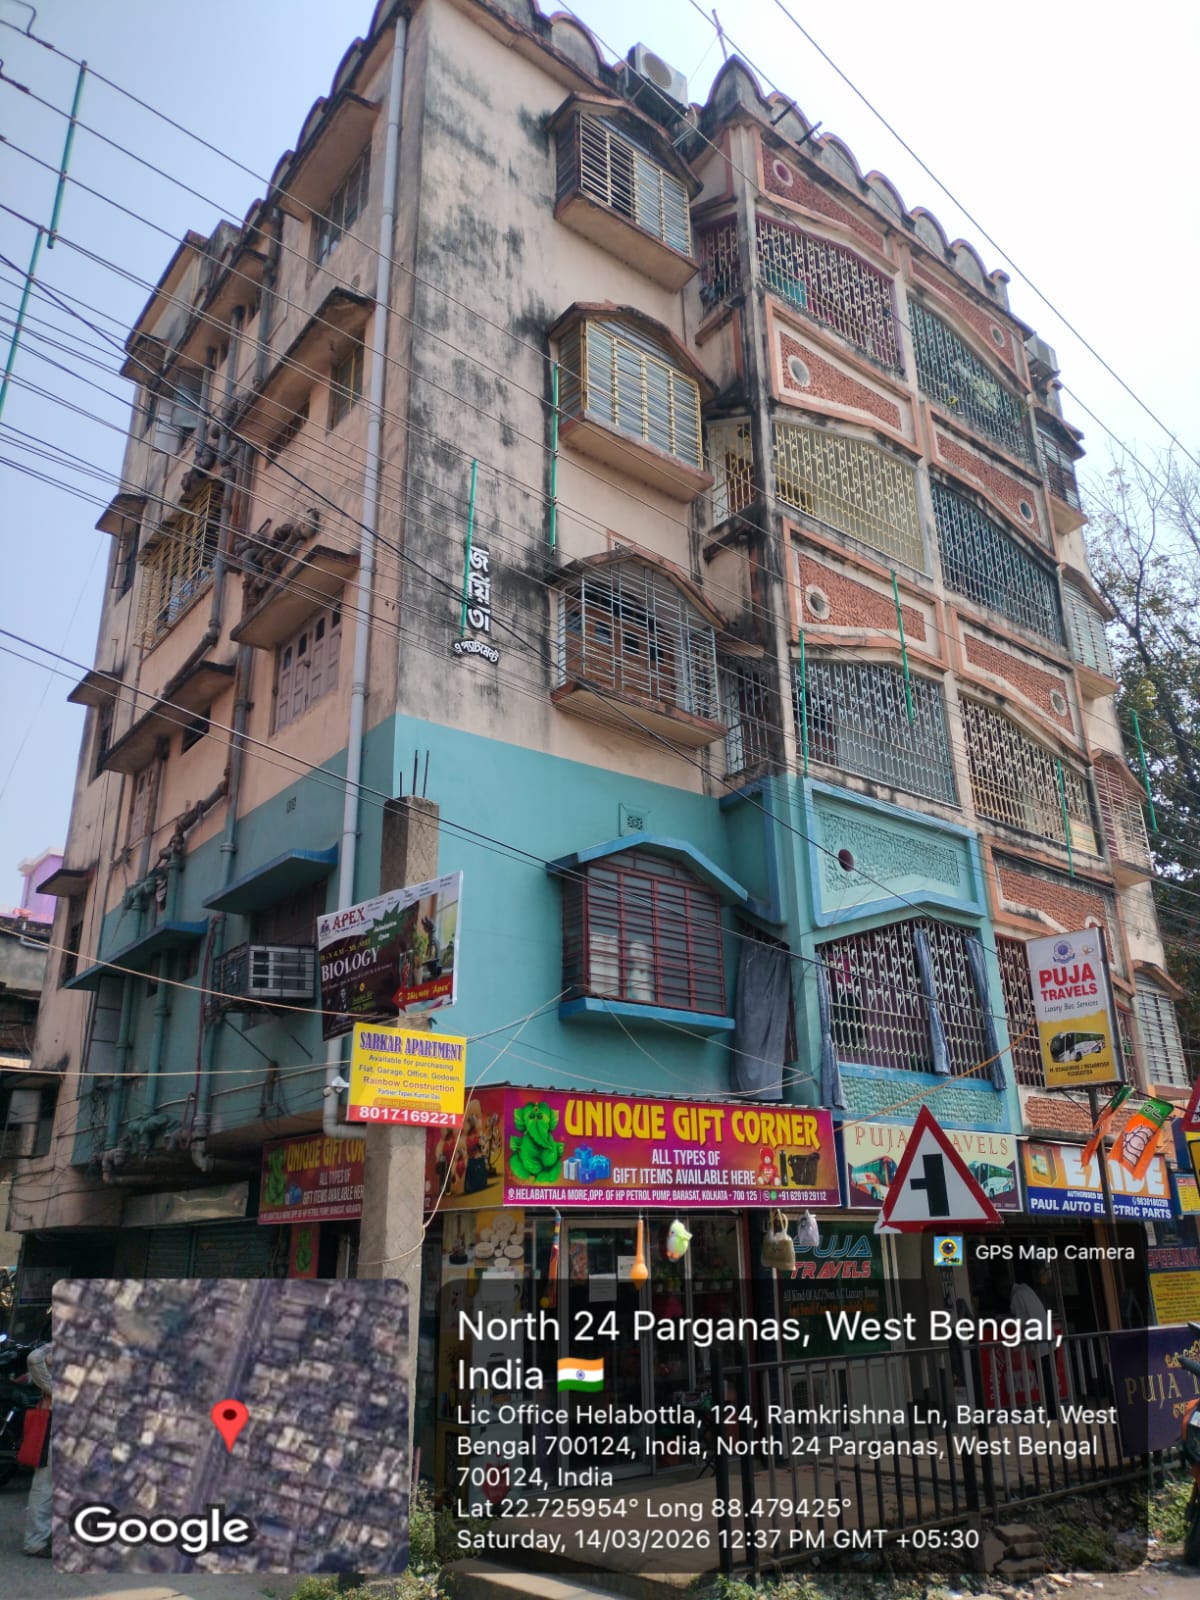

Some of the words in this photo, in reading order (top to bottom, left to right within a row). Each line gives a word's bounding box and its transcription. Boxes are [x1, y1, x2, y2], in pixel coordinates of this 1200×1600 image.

[332, 907, 366, 930] APEX
[321, 945, 380, 982] BIOLOGY
[1038, 963, 1096, 988] PUJA
[1040, 983, 1098, 1002] TRAVELS
[1044, 1004, 1063, 1014] Luxury
[1064, 1002, 1075, 1010] Bus
[360, 1031, 403, 1054] SARKAR
[404, 1037, 464, 1062] APARTMENT
[368, 1055, 401, 1065] Available
[415, 1059, 454, 1071] purchasing
[363, 1076, 400, 1087] Rainbow
[403, 1080, 454, 1093] Construction
[359, 1106, 457, 1125] 8017169221
[564, 1099, 666, 1140] UNIQUE
[673, 1107, 725, 1145] GIFT
[731, 1110, 821, 1149] CORNER
[855, 1126, 909, 1153] PUJA
[952, 1136, 1009, 1156] AVELS
[287, 1140, 321, 1172] UNIQUE
[322, 1137, 342, 1168] GIFT
[651, 1149, 671, 1165] ALL
[673, 1150, 705, 1166] TYPES
[708, 1150, 720, 1166] OF
[613, 1168, 637, 1184] GIFT
[640, 1168, 673, 1185] ITEMS
[675, 1169, 729, 1185] AVAILABLE
[731, 1170, 756, 1185] HERE
[353, 1185, 364, 1200] HER
[515, 1188, 566, 1200] HELABATTALA
[605, 1189, 614, 1200] OF
[616, 1189, 625, 1200] HP
[626, 1189, 651, 1201] PETROL
[652, 1190, 671, 1202] PUMP,
[672, 1190, 701, 1202] BARASAT,
[702, 1190, 728, 1201] KOLKATA
[733, 1190, 745, 1201] 700
[746, 1190, 758, 1201] 125
[1030, 1197, 1059, 1211] PAUL
[1062, 1200, 1091, 1212] AUTO
[1094, 1202, 1140, 1217] ELCTRIC
[1142, 1207, 1172, 1219] PARTS
[790, 1260, 872, 1279] TRAVELS
[1124, 1372, 1182, 1409] PUJA
